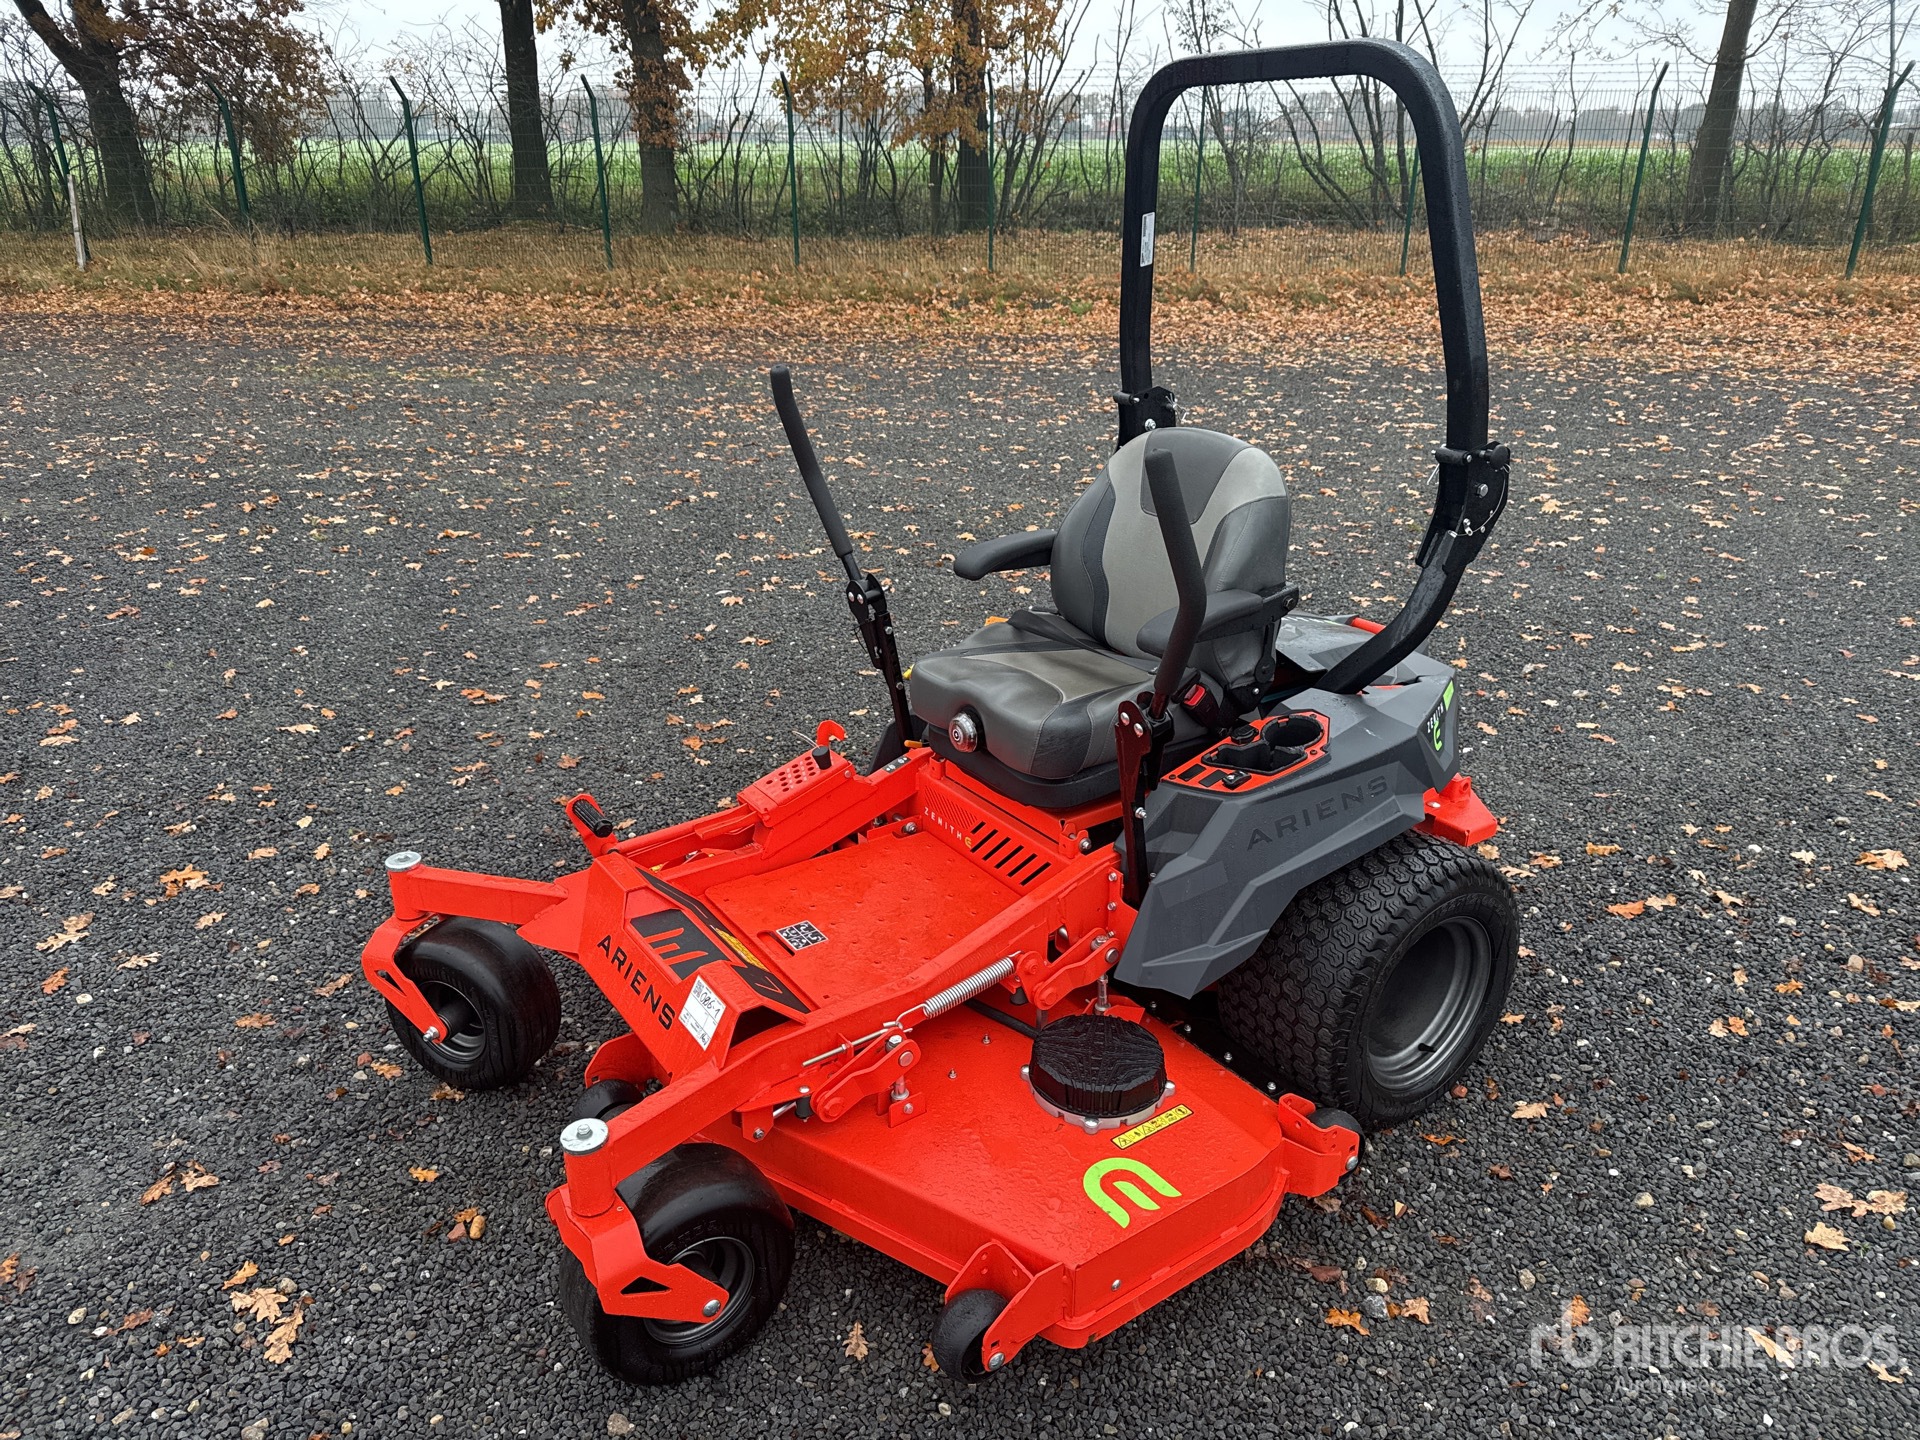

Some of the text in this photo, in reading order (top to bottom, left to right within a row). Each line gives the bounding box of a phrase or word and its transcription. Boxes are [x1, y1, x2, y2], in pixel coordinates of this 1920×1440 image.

[923, 806, 962, 840] ZENITH
[1247, 775, 1388, 851] ARIENS
[597, 934, 676, 1031] ARIENS
